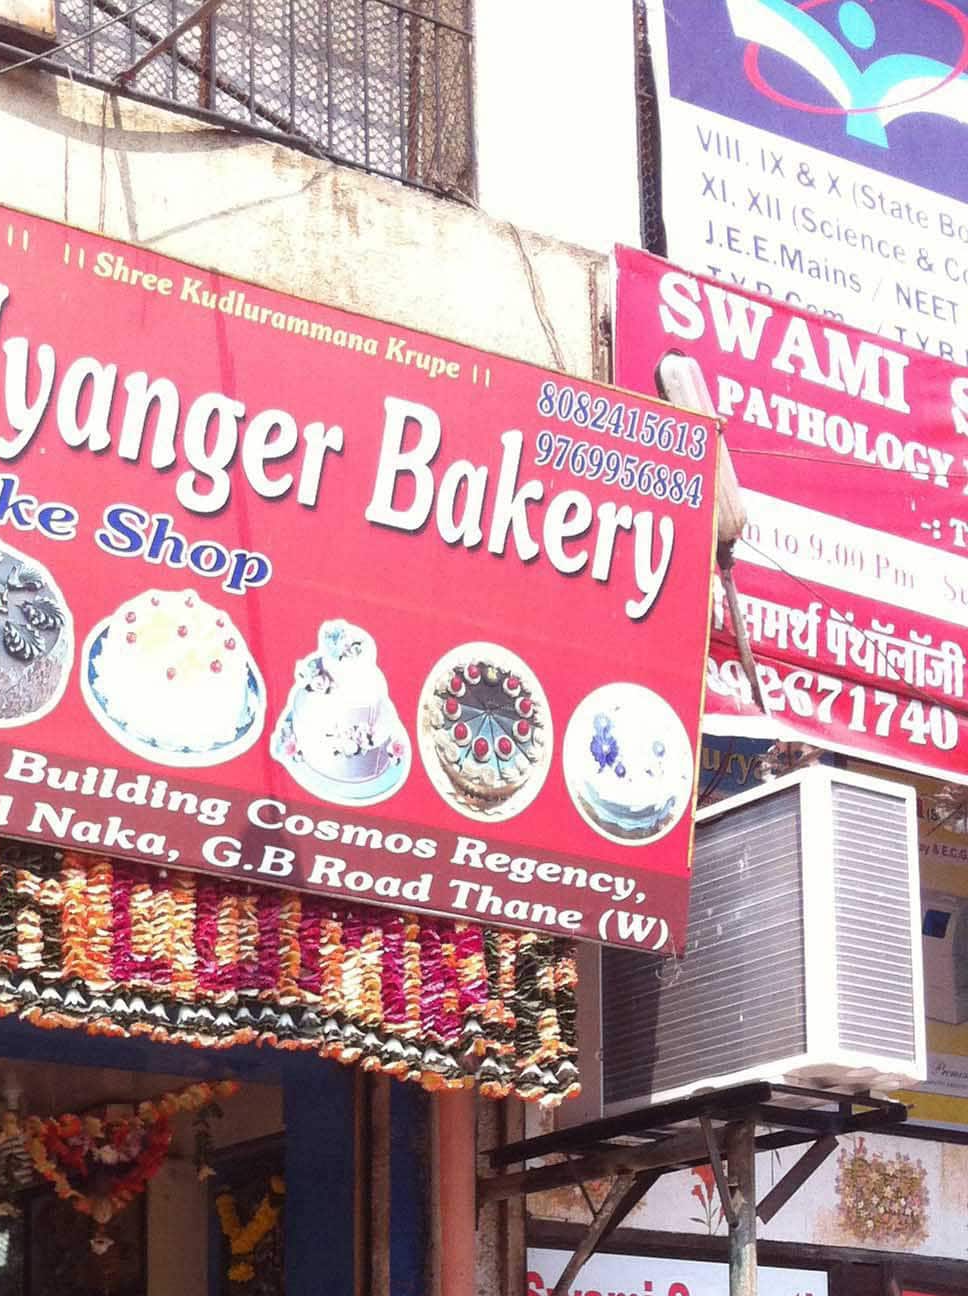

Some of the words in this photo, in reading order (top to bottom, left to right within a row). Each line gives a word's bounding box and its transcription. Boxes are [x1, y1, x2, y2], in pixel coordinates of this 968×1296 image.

[760, 147, 784, 179] IX
[796, 161, 817, 190] &
[828, 170, 843, 200] X
[852, 181, 929, 231] (State
[792, 203, 906, 264] (Science
[916, 245, 934, 273] &
[93, 251, 174, 296] Shree
[178, 276, 379, 359] Kudlurammana
[384, 336, 462, 382] Krupe
[657, 271, 911, 414] SWAMI
[895, 281, 959, 326] NEET
[534, 429, 705, 509] 9769956884
[536, 382, 708, 461] 8082415613
[716, 375, 956, 488] PATHOLOGY
[98, 504, 273, 593] Shop
[365, 396, 676, 620] Bakery
[4, 748, 229, 827] Building
[246, 798, 438, 859] Cosmos
[449, 837, 647, 903] Regency,
[27, 801, 181, 865] Naka,
[201, 833, 294, 879] G.B
[308, 856, 432, 904] Road
[447, 878, 584, 931] Thane
[597, 909, 670, 951] (W)
